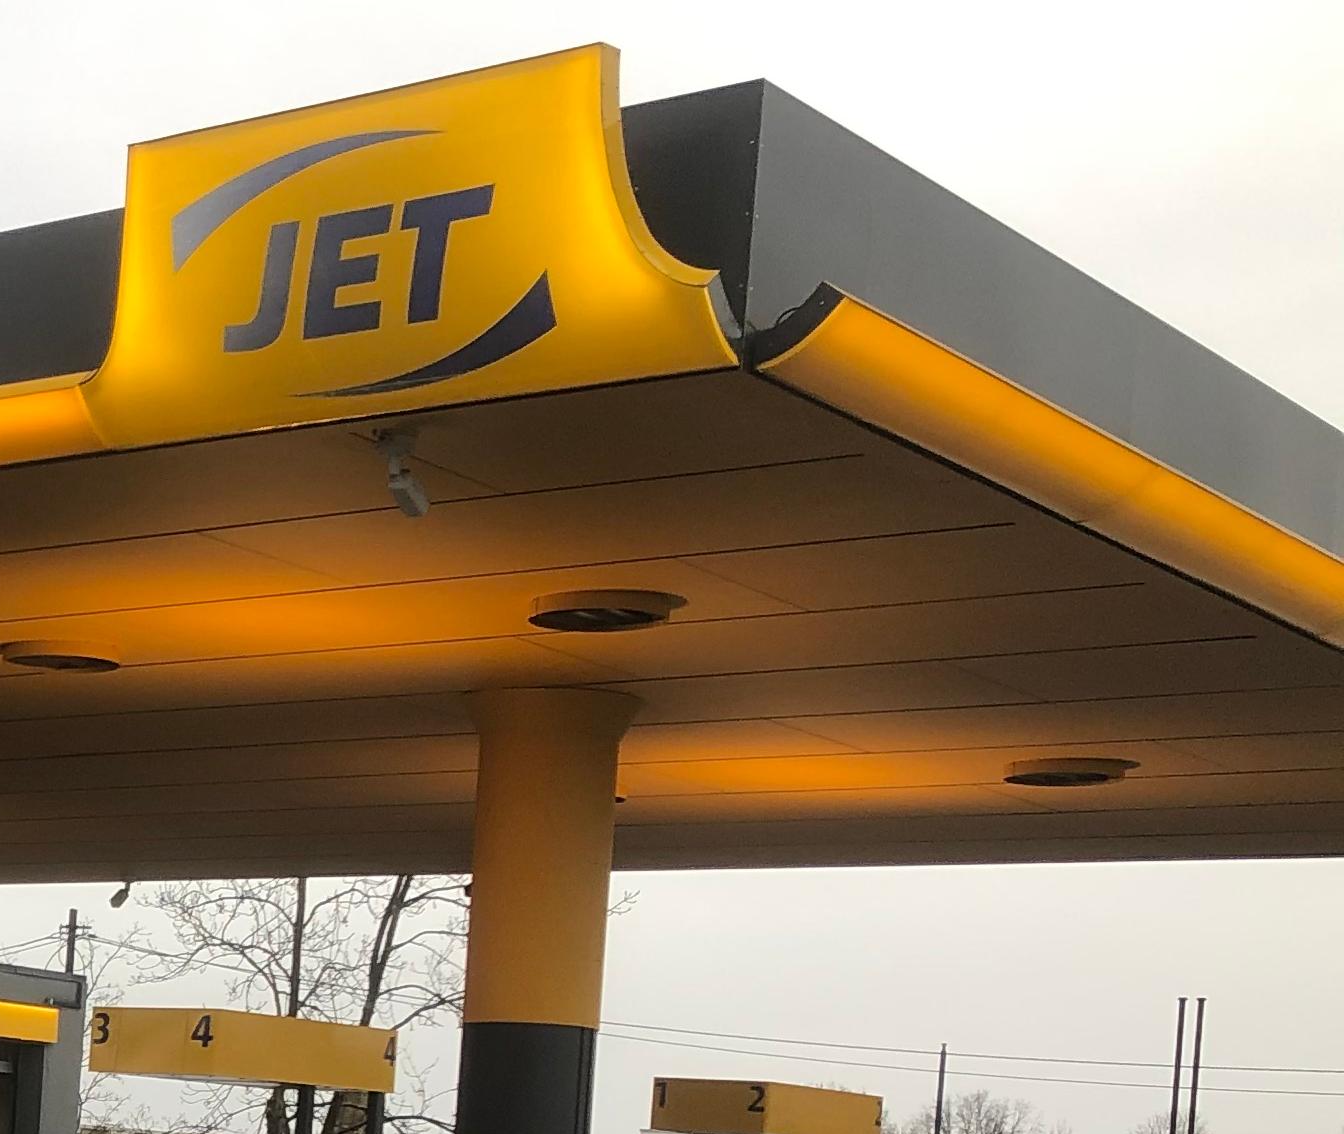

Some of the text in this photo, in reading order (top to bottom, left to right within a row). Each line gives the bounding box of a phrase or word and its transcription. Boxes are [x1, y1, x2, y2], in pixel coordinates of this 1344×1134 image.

[222, 182, 496, 354] JET
[91, 1012, 111, 1045] 3
[190, 1014, 214, 1048] 4
[382, 1035, 397, 1067] 4
[654, 1081, 669, 1109] 1
[747, 1085, 766, 1112] 2
